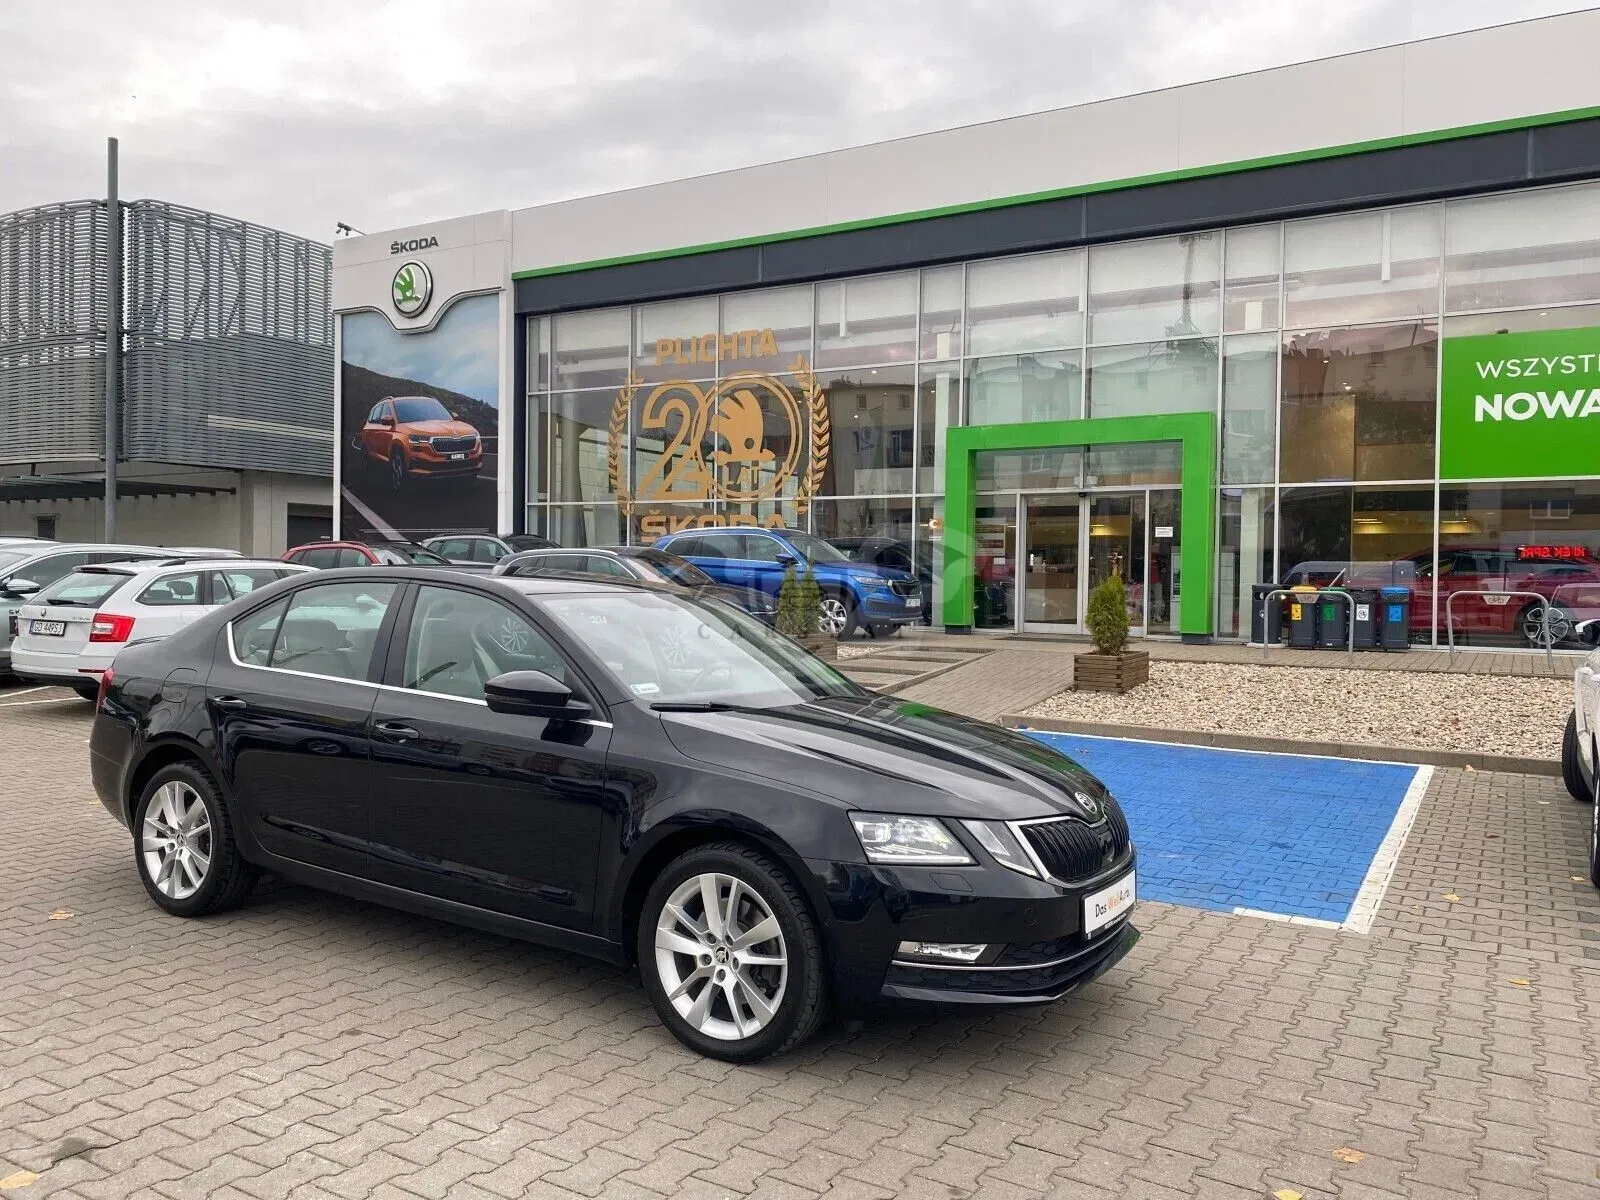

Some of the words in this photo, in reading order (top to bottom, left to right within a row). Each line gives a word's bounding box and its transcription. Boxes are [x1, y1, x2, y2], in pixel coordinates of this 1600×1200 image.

[390, 236, 439, 254] ŠKODA
[655, 328, 779, 366] PLICHTA
[1475, 353, 1600, 379] WSZYST
[1474, 388, 1600, 422] NOWA
[722, 463, 759, 485] LAT
[1095, 903, 1107, 918] Das
